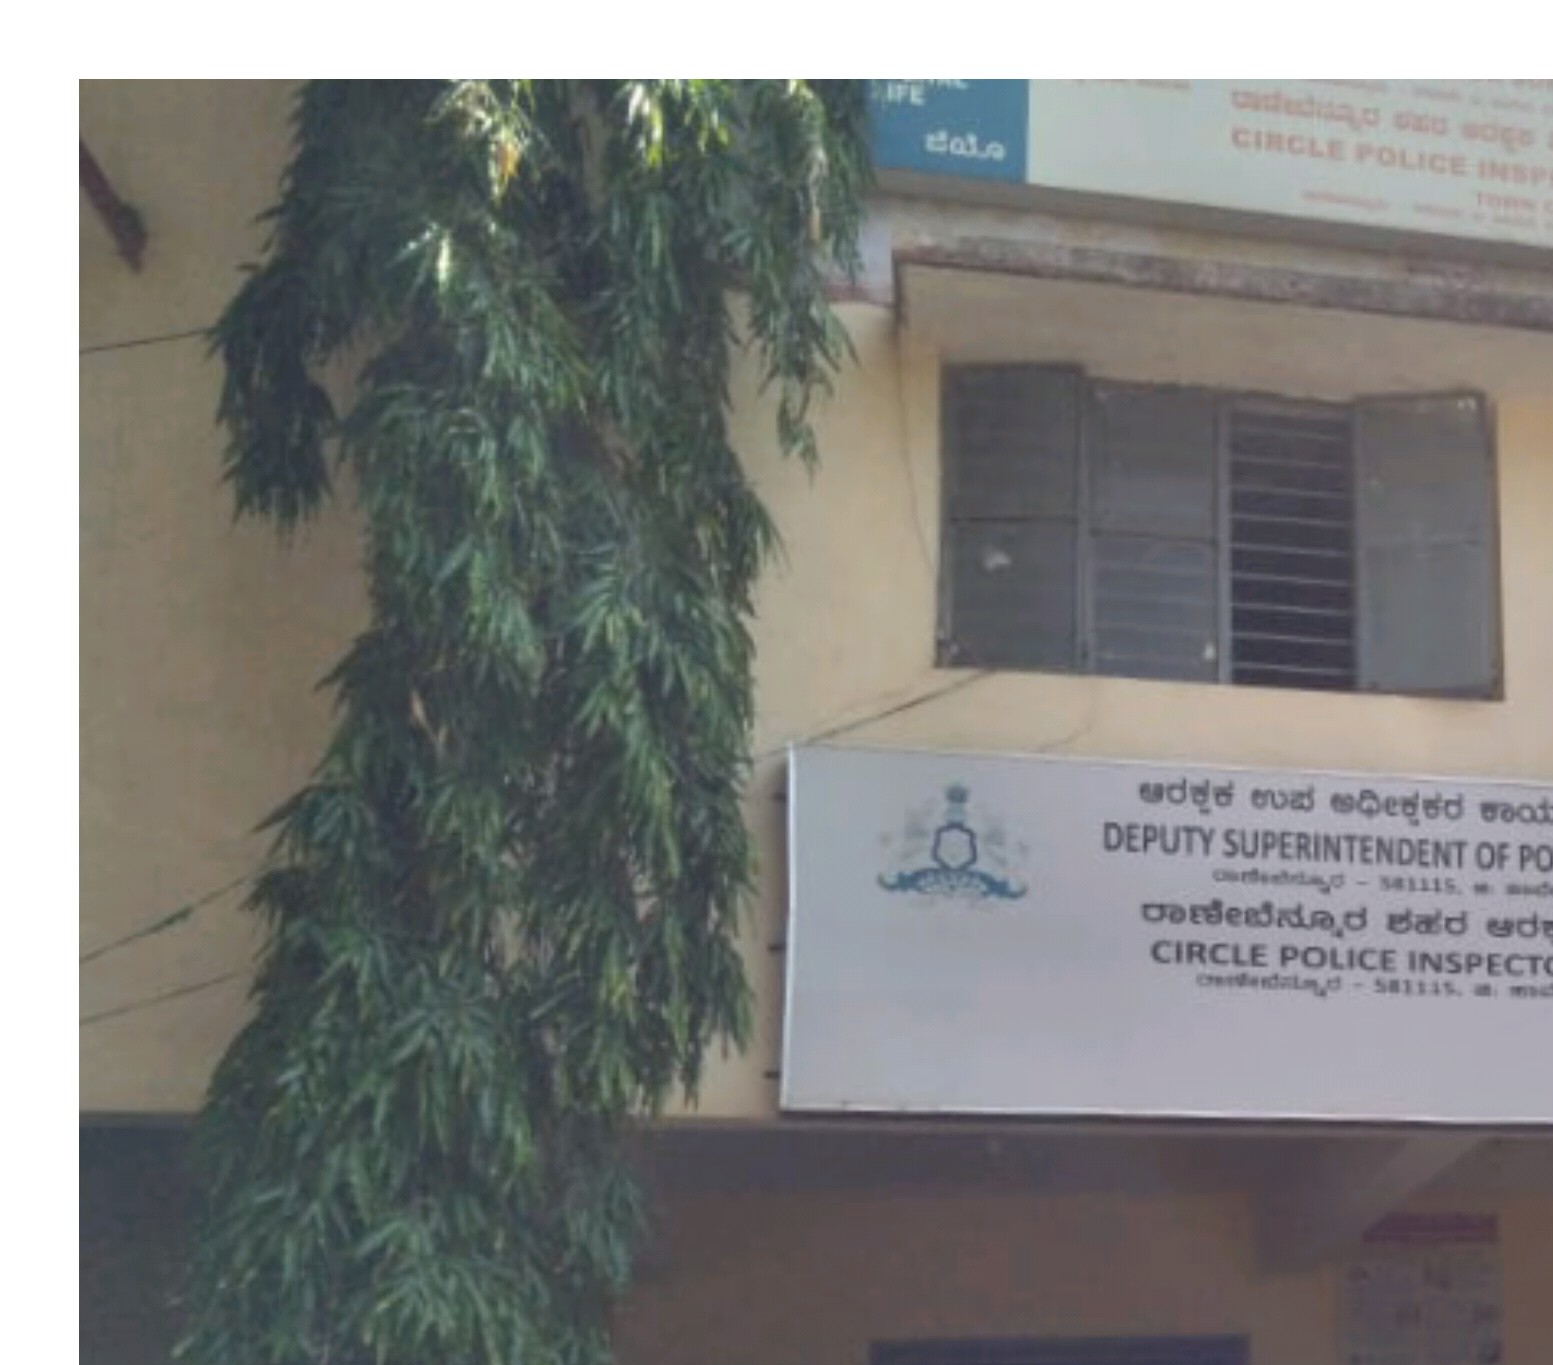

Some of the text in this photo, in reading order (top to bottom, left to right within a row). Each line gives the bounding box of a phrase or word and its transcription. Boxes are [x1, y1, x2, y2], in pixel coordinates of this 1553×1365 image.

[1231, 126, 1344, 161] CIRCLE
[1355, 144, 1468, 175] POLICE
[1251, 785, 1315, 813] ಉಪ
[1103, 821, 1216, 856] DEPUTY
[1222, 827, 1469, 869] SUPERINTENDENT
[1475, 840, 1510, 871] OF
[1151, 939, 1269, 968] CIRCLE
[1280, 944, 1397, 972] POLICE
